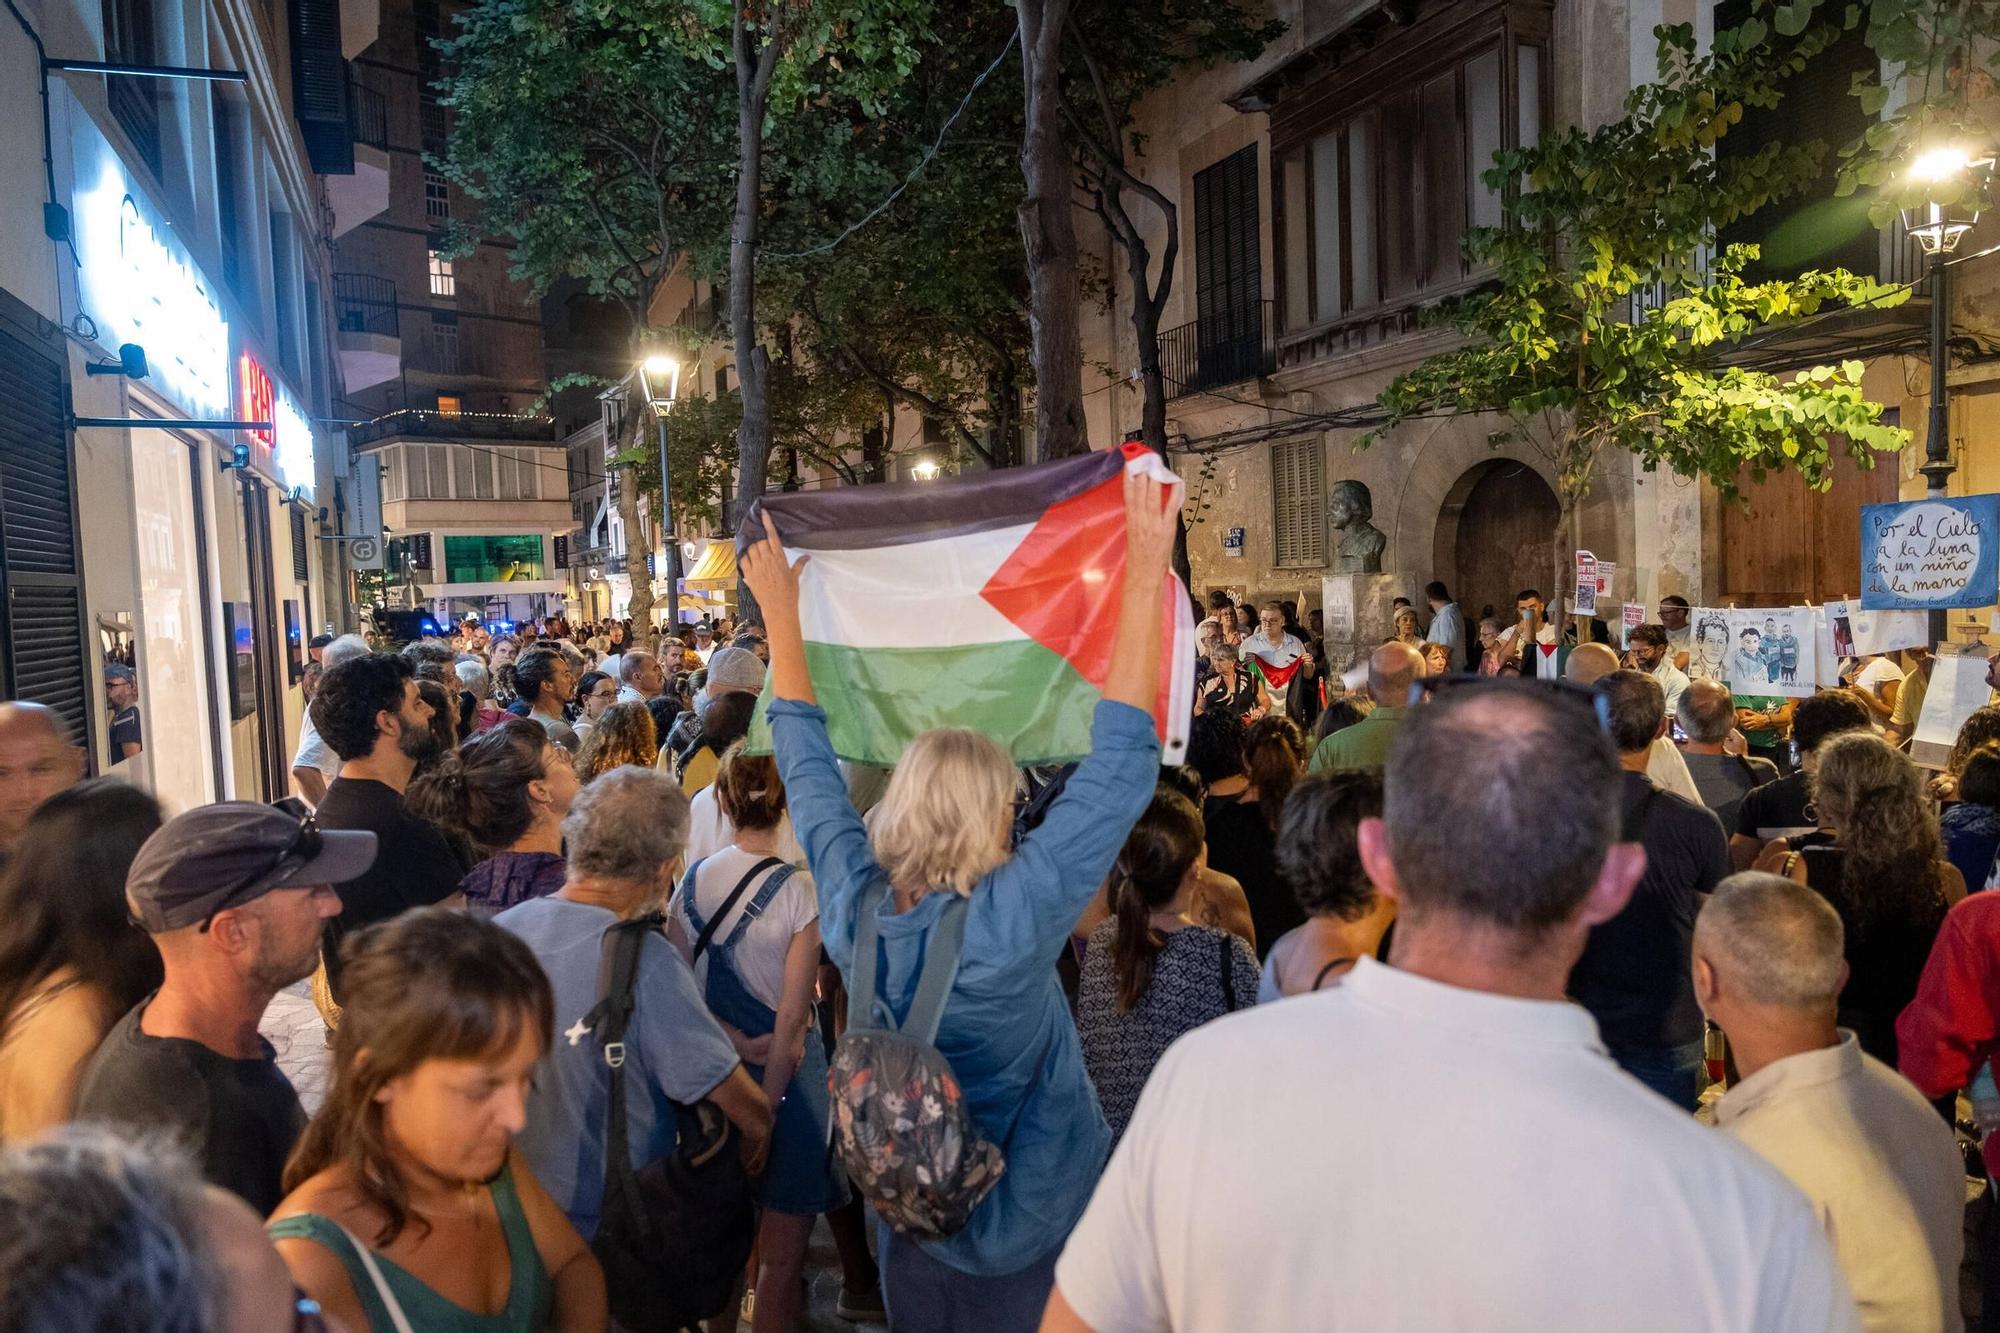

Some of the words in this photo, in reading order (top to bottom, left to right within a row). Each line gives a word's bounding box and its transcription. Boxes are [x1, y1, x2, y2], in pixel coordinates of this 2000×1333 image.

[1874, 516, 1905, 538] Por
[1907, 514, 1927, 538] el
[1936, 509, 1984, 539] Cielo
[1872, 544, 1891, 559] va
[1898, 541, 1919, 558] la
[1924, 537, 1976, 558] luna
[1867, 561, 1889, 574] con
[1895, 561, 1916, 574] un
[1921, 556, 1974, 572] niño
[1868, 579, 1886, 594] de
[1887, 575, 1909, 594] la
[1912, 576, 1968, 593] mano
[1960, 595, 1993, 606] Lorca
